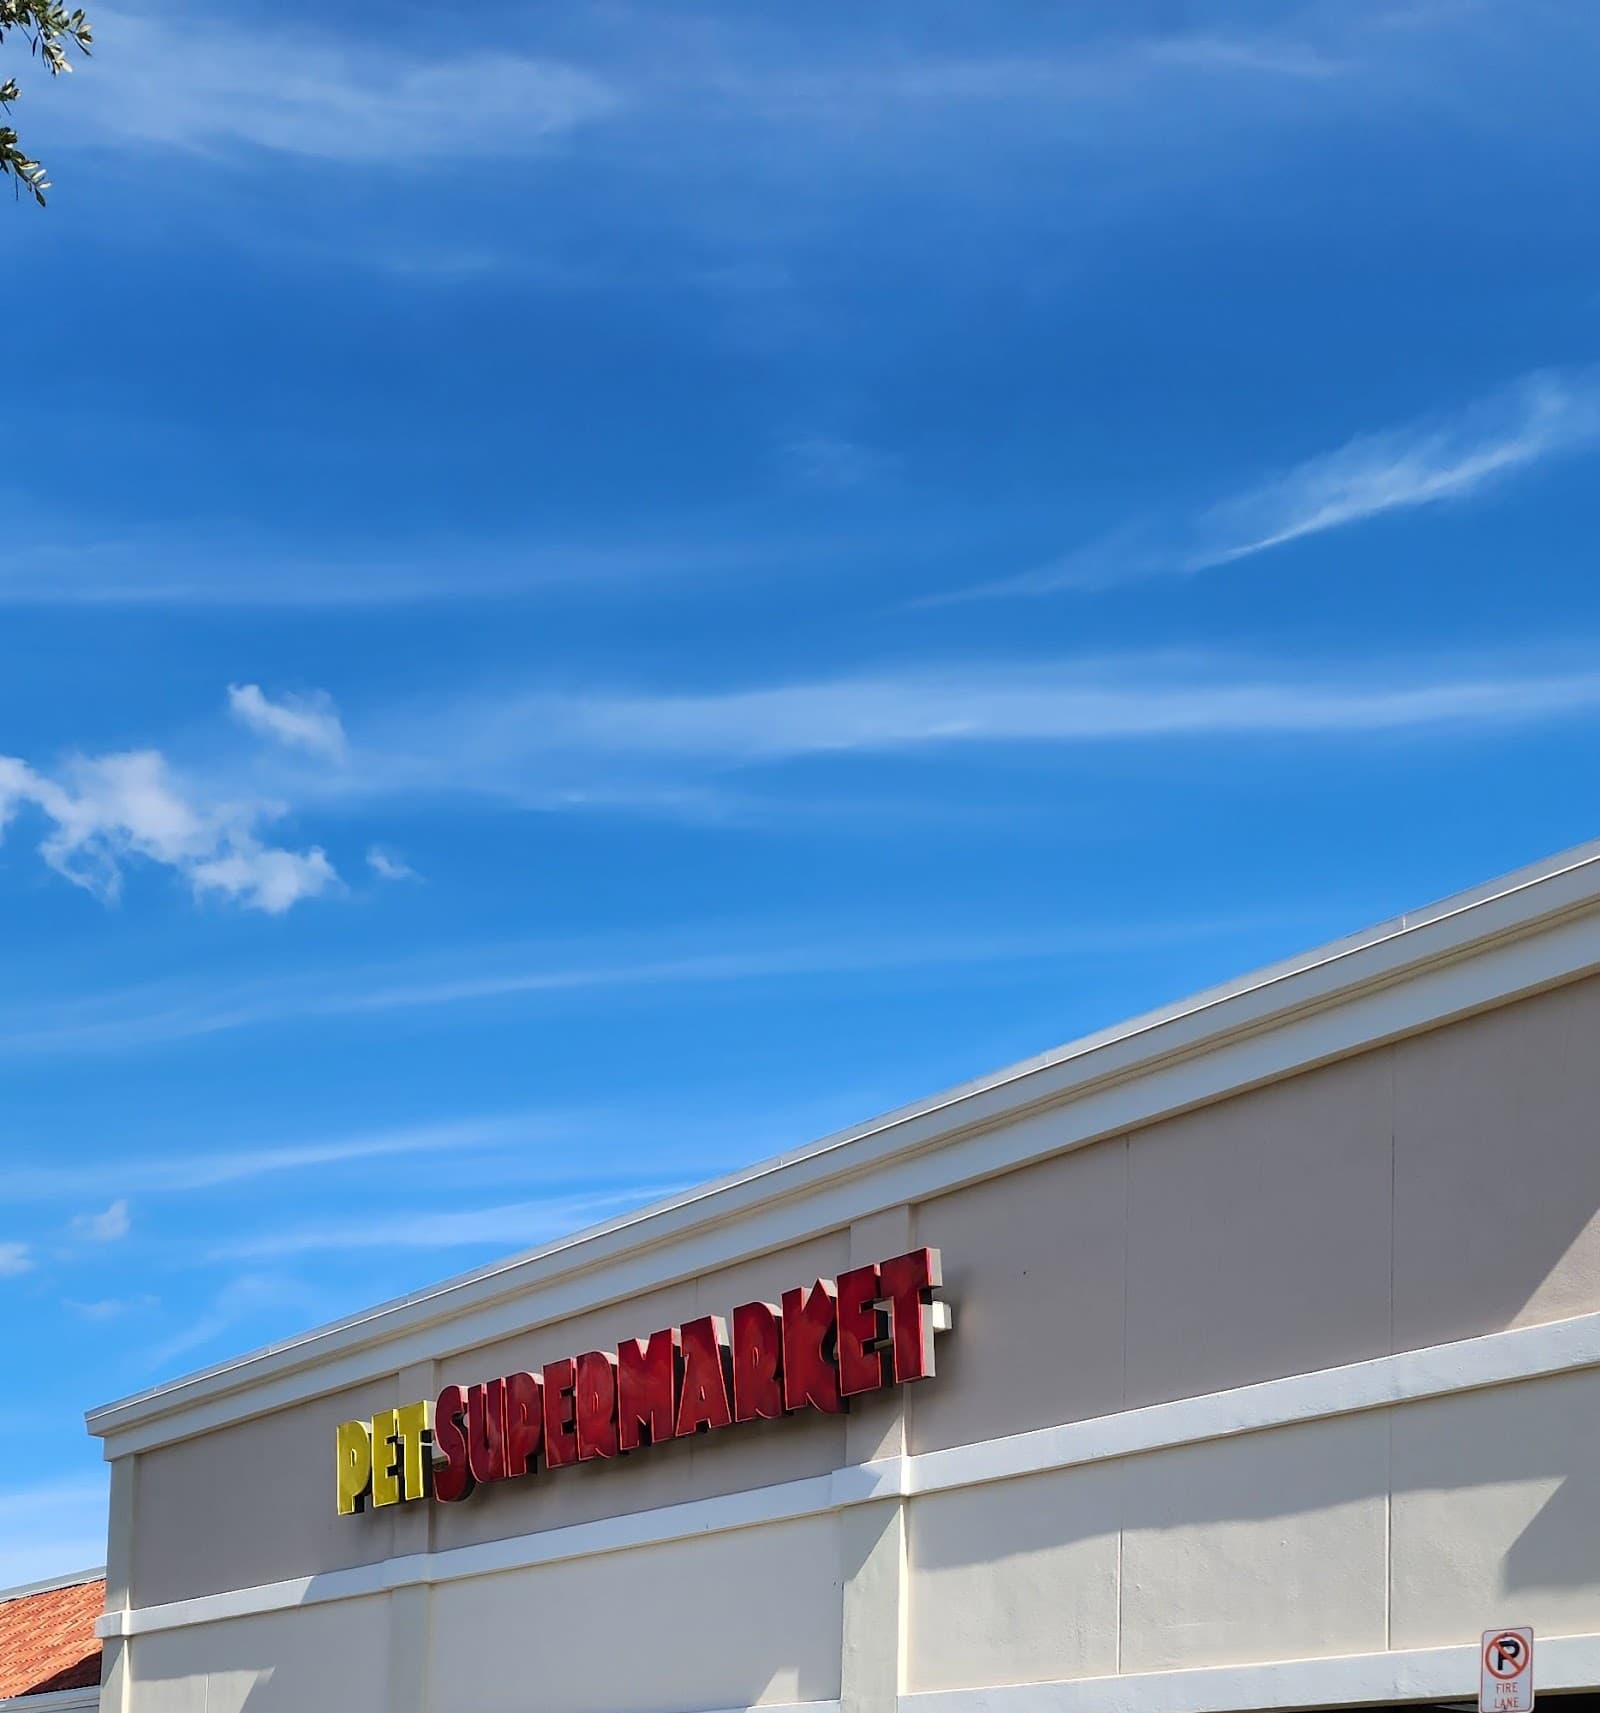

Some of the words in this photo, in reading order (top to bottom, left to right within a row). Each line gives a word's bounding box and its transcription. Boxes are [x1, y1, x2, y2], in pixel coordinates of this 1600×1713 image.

[336, 1400, 430, 1516] PET
[434, 1247, 939, 1503] SUPERMARKET
[1496, 1682, 1519, 1695] FIRE
[1494, 1697, 1520, 1710] LANE
